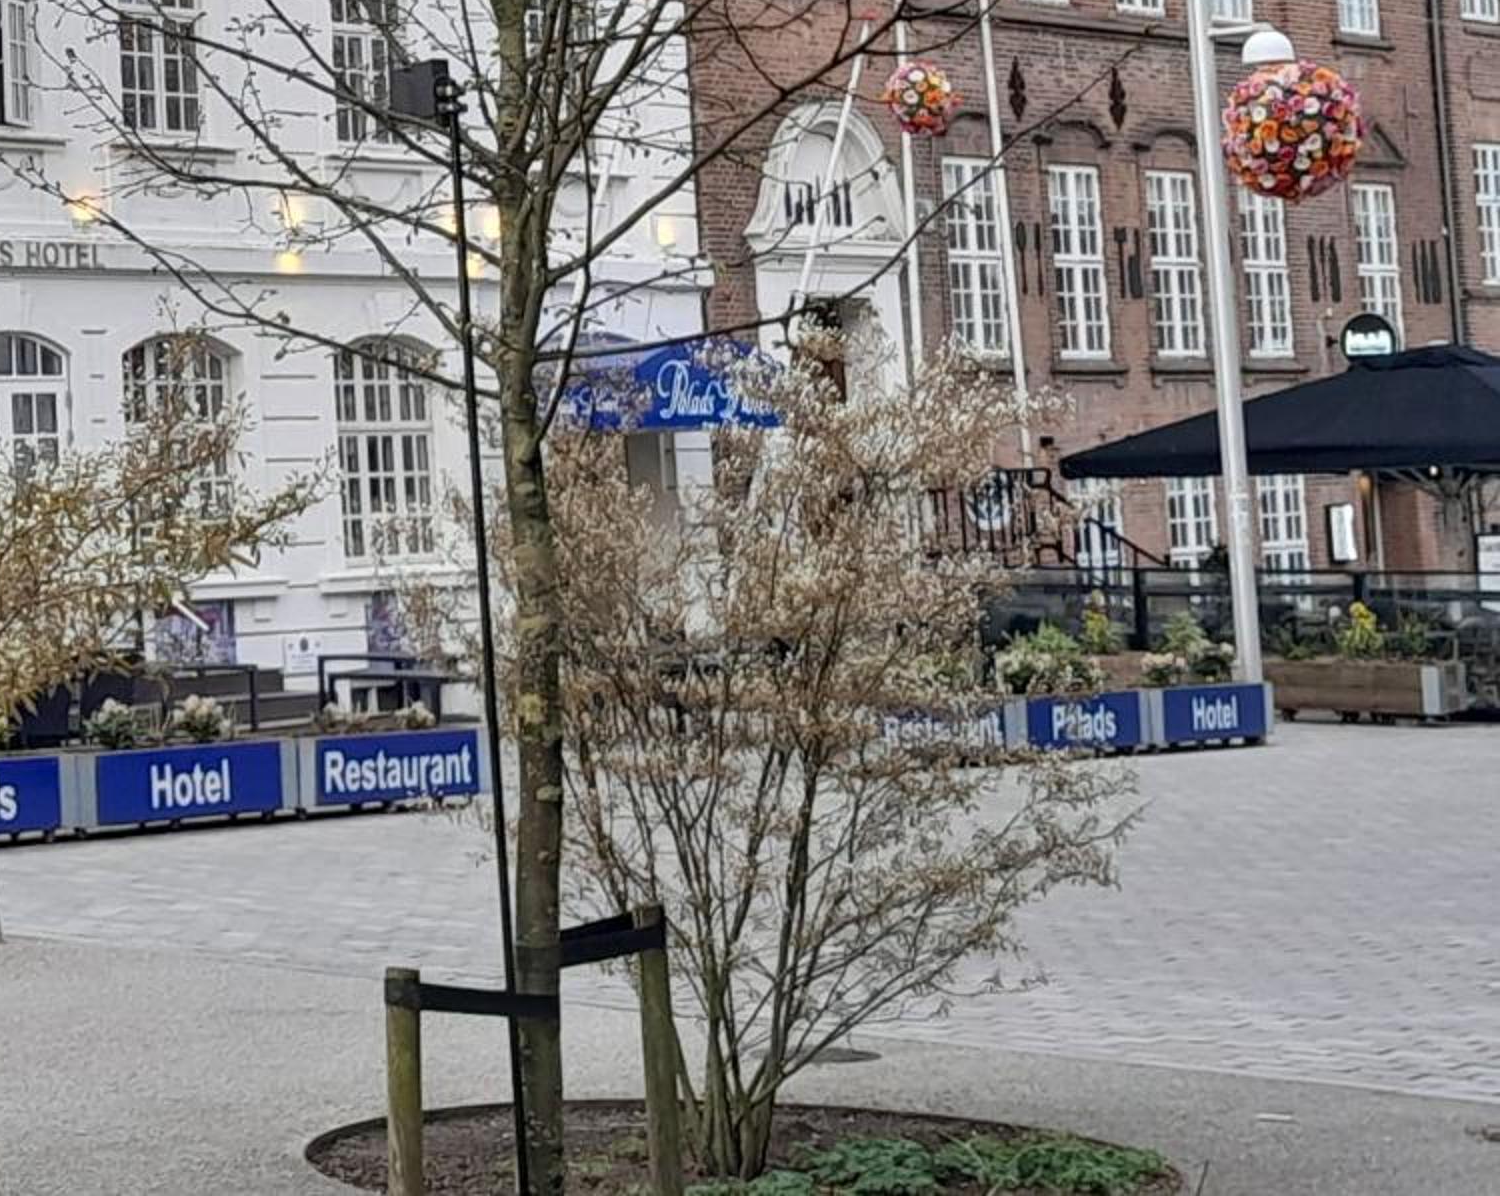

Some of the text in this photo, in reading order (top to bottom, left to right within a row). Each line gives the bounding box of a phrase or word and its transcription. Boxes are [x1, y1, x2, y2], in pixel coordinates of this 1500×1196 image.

[25, 241, 106, 270] HOTEL
[1191, 694, 1239, 731] Hotel
[150, 758, 231, 808] Hotel
[323, 743, 473, 793] Restaurant
